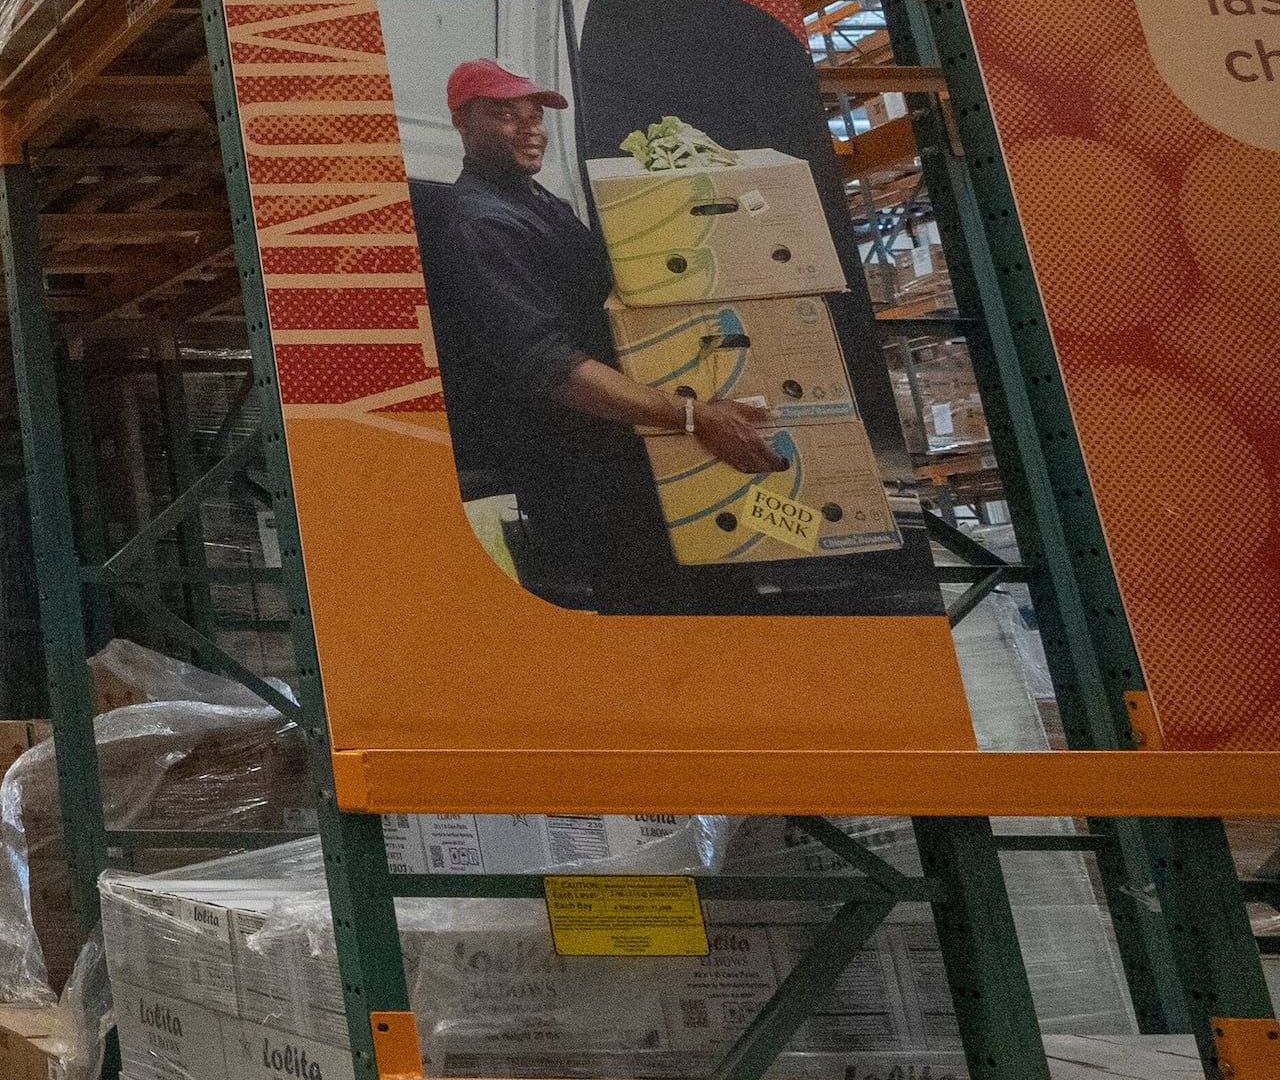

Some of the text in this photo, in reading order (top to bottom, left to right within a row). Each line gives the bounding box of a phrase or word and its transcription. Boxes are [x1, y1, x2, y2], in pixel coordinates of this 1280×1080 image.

[751, 505, 811, 538] BANK
[755, 491, 813, 523] FOOD
[194, 906, 220, 928] lolita
[140, 997, 183, 1037] lolita
[262, 1037, 323, 1080] lolita
